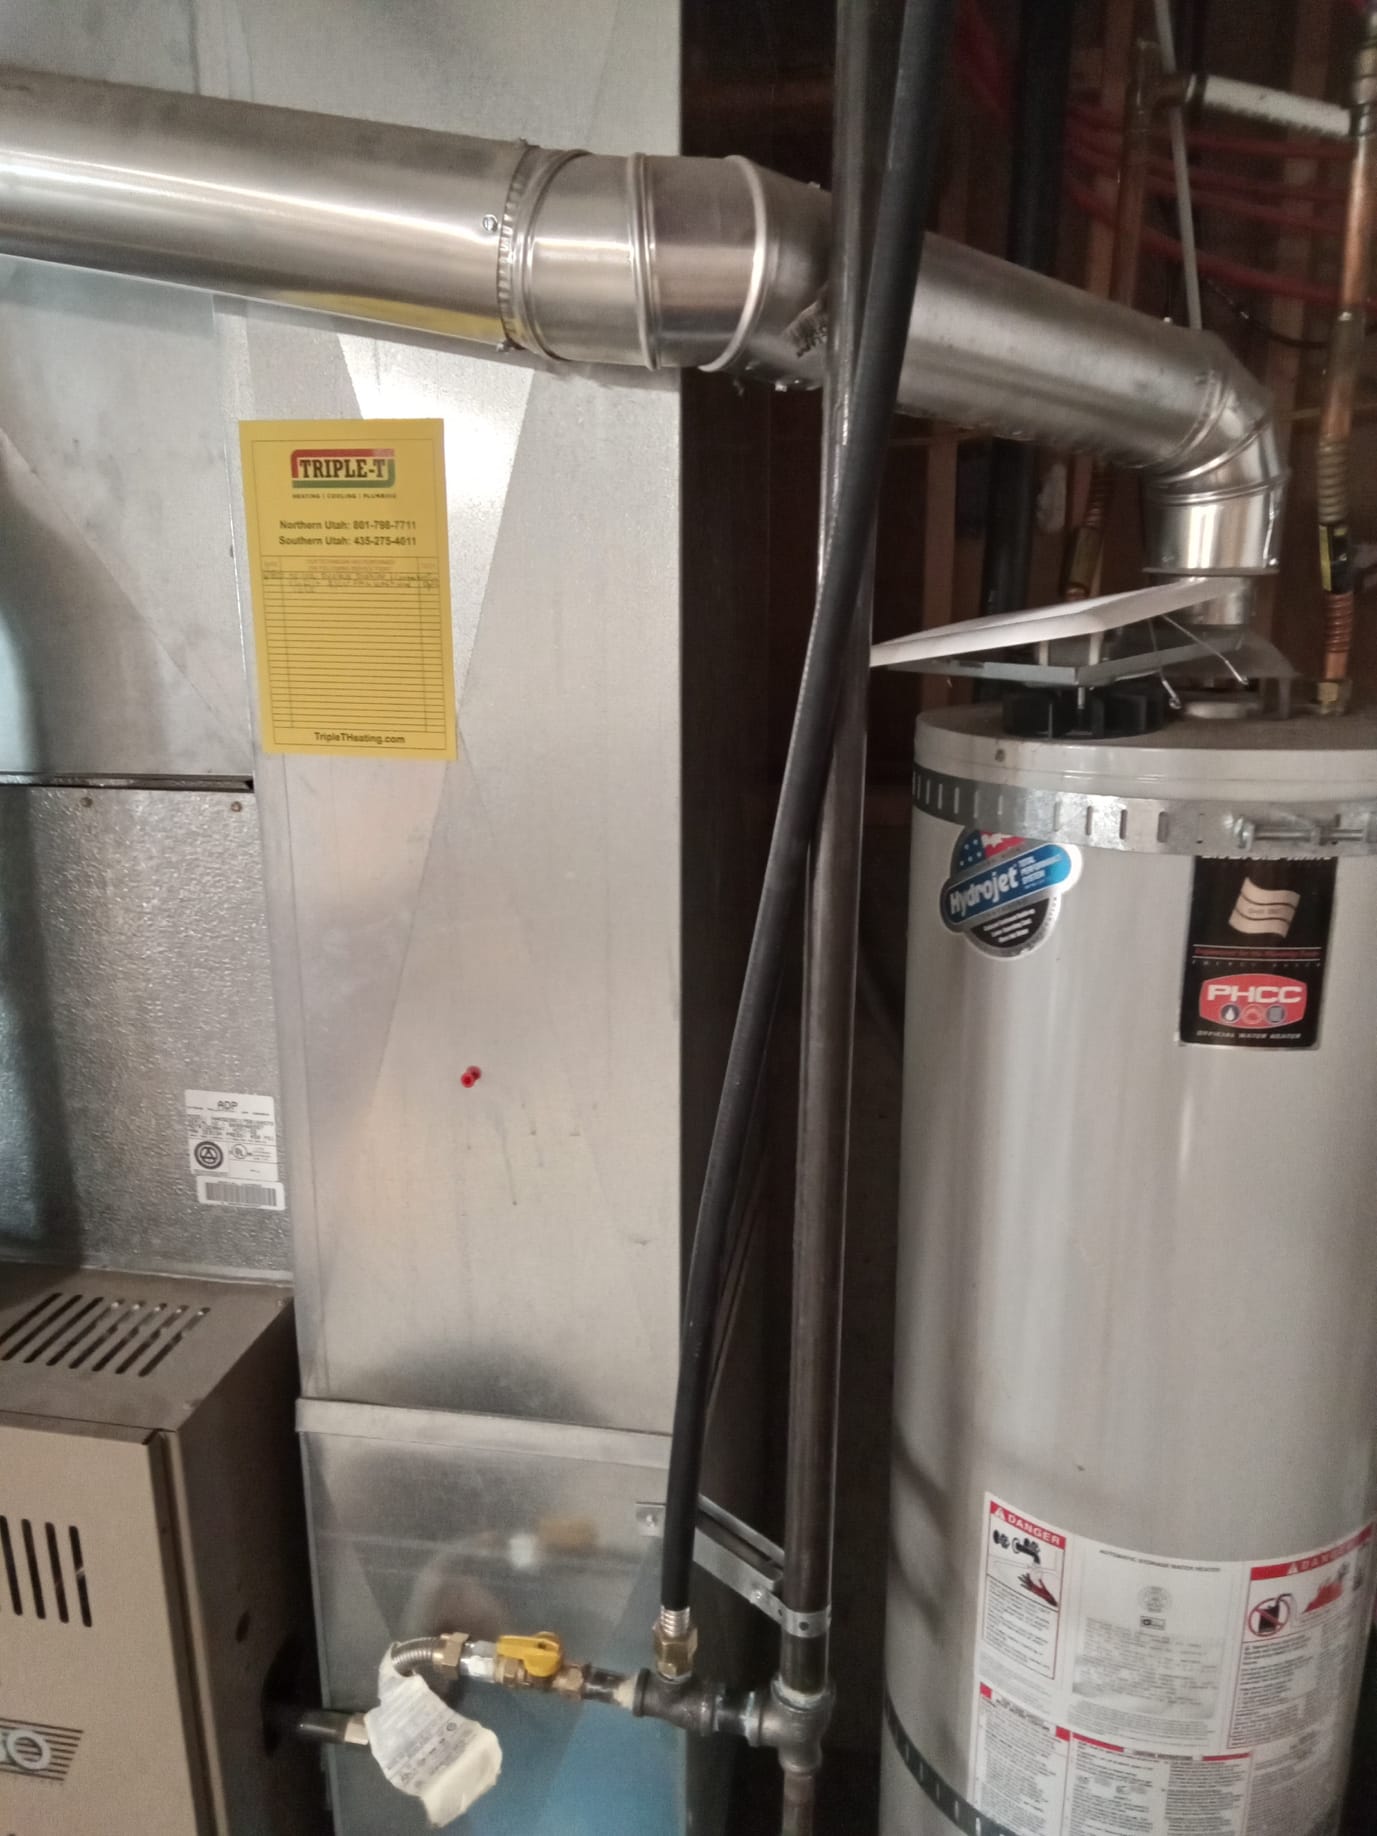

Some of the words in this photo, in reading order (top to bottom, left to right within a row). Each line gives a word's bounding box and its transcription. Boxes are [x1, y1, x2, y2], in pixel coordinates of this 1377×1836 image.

[299, 458, 386, 479] TRIPLE-T
[279, 520, 322, 530] Northern
[324, 520, 351, 530] Utah:
[278, 535, 323, 546] Southern
[325, 535, 351, 546] Utah:
[313, 731, 406, 745] TripleTHeating.com
[950, 864, 1018, 917] Hydrojet
[1207, 984, 1303, 1004] PHCC
[1007, 1513, 1061, 1547] DANGER
